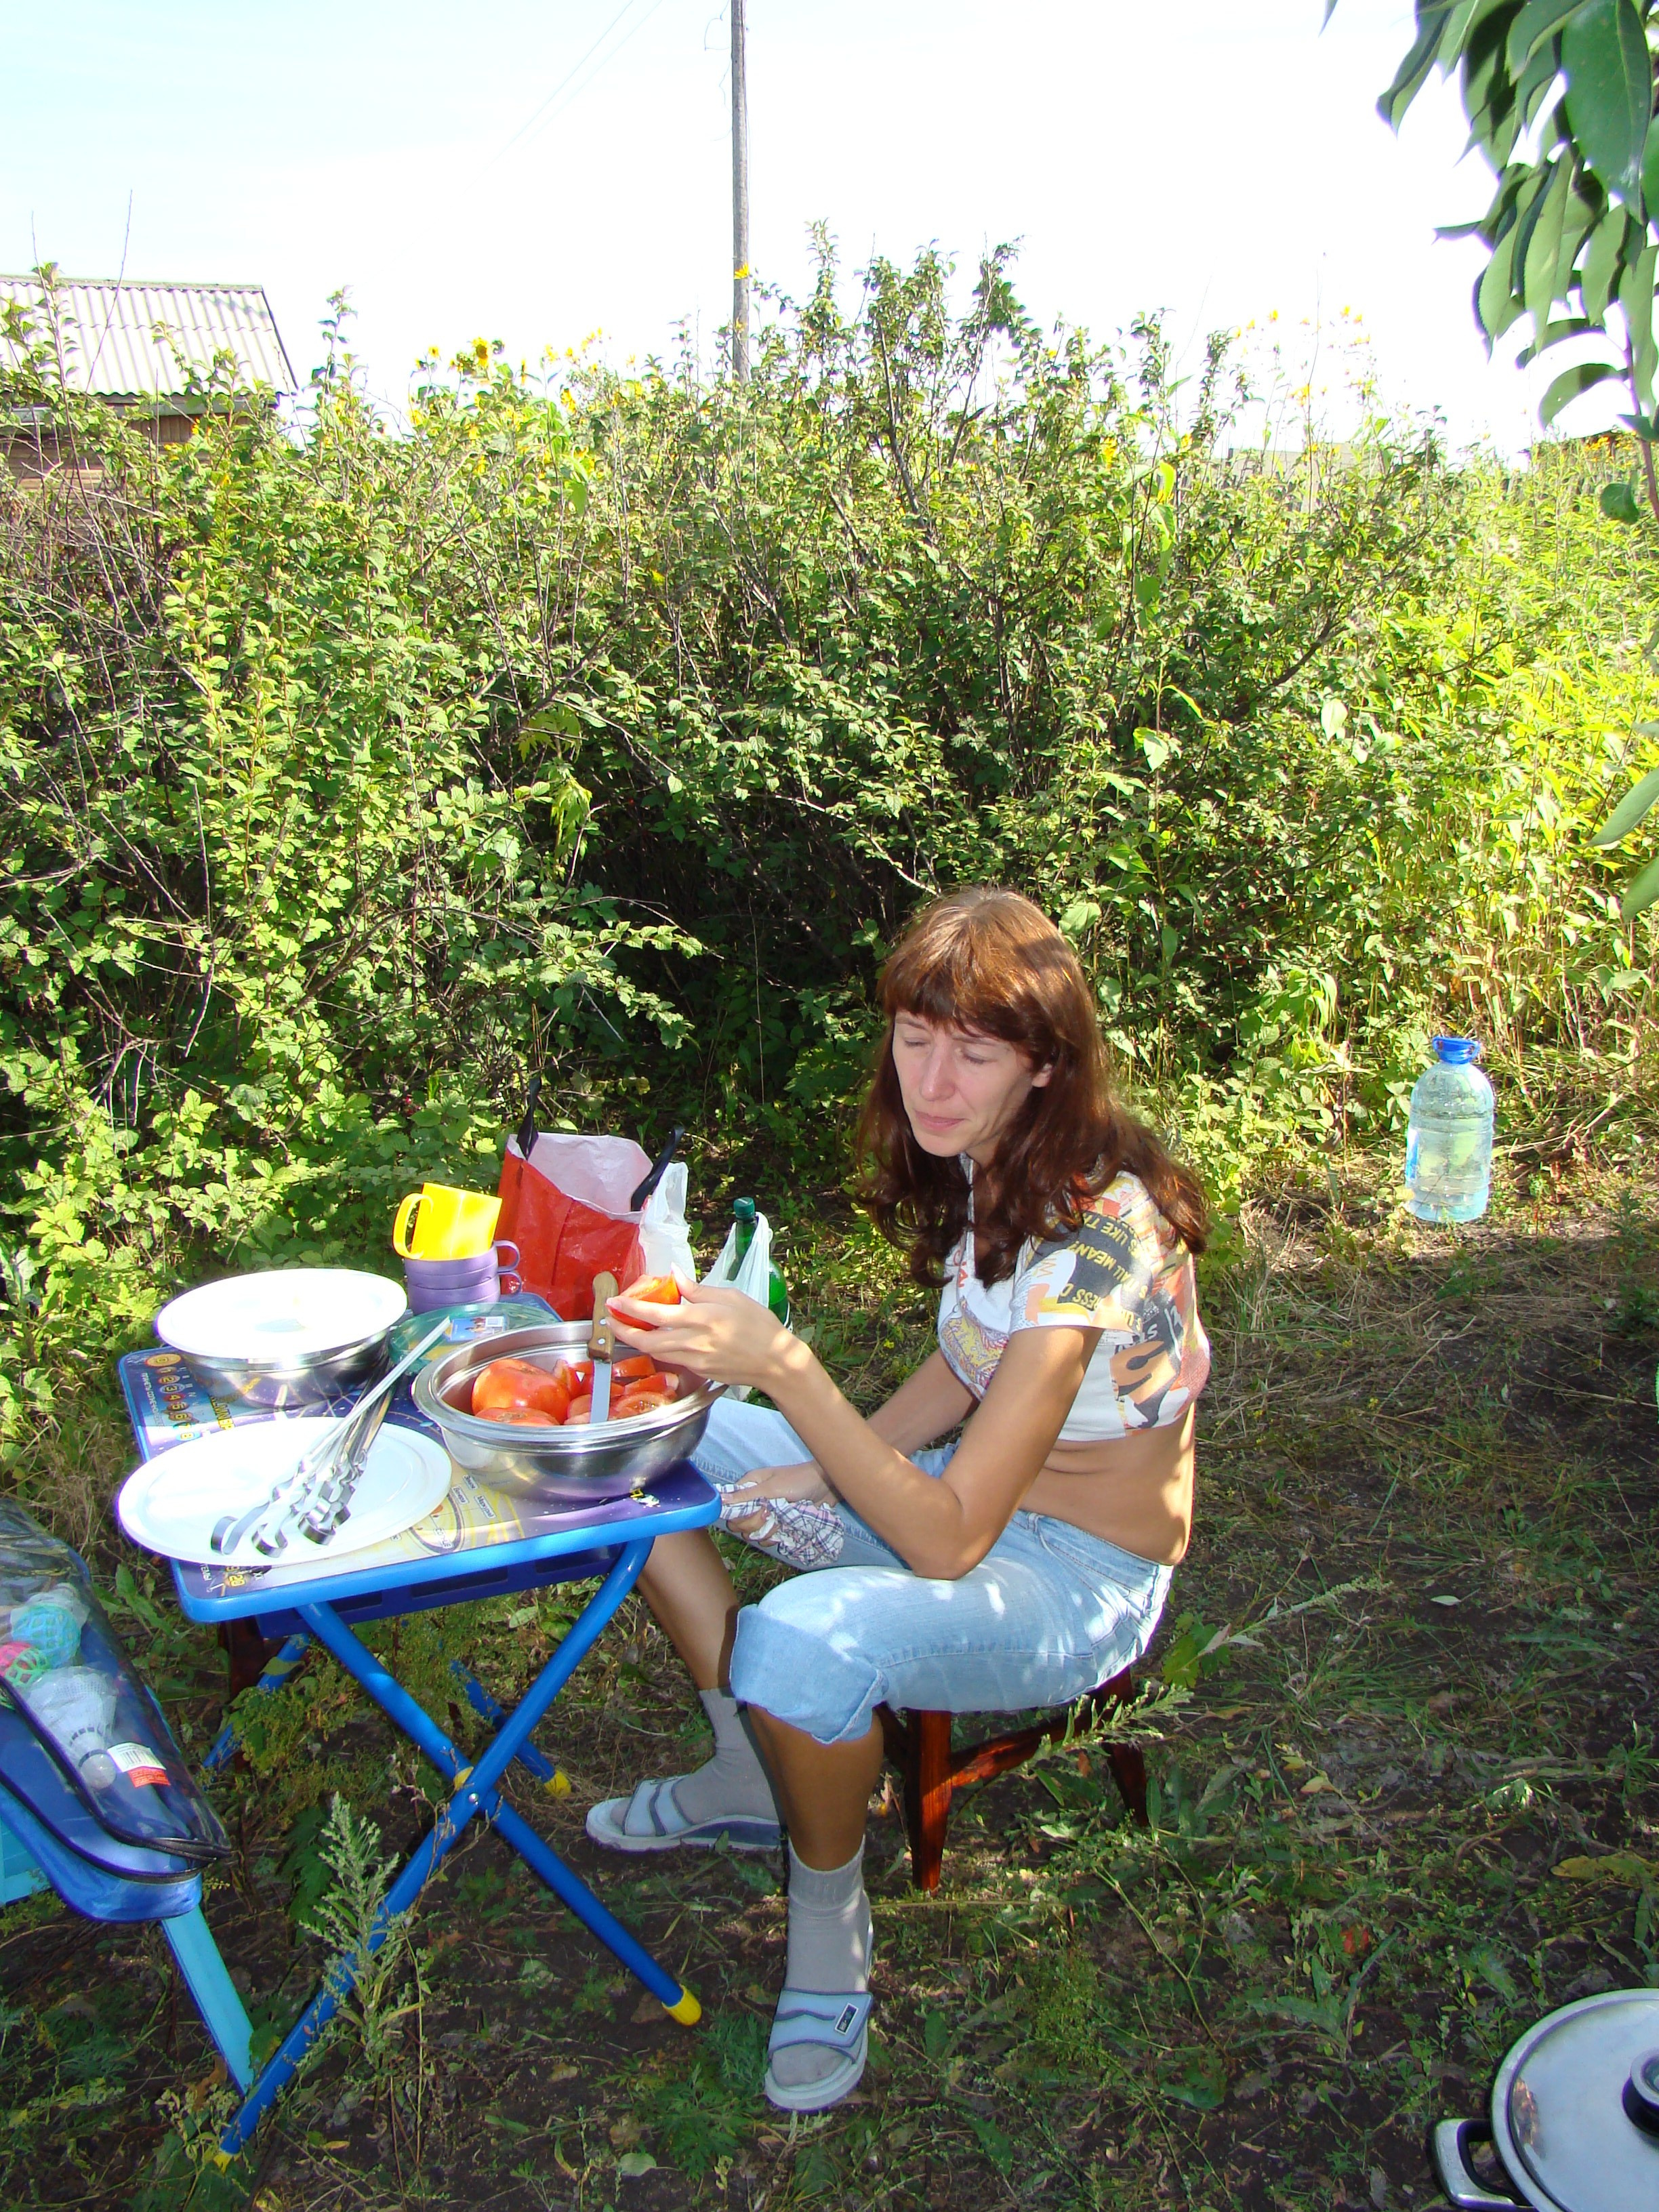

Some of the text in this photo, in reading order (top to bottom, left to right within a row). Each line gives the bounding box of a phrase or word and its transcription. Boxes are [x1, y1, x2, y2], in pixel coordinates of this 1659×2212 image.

[1101, 1222, 1128, 1246] LIKE
[1068, 1241, 1117, 1271] MEAN?
[1113, 1265, 1131, 1282] ALL
[229, 1574, 245, 1586] 20
